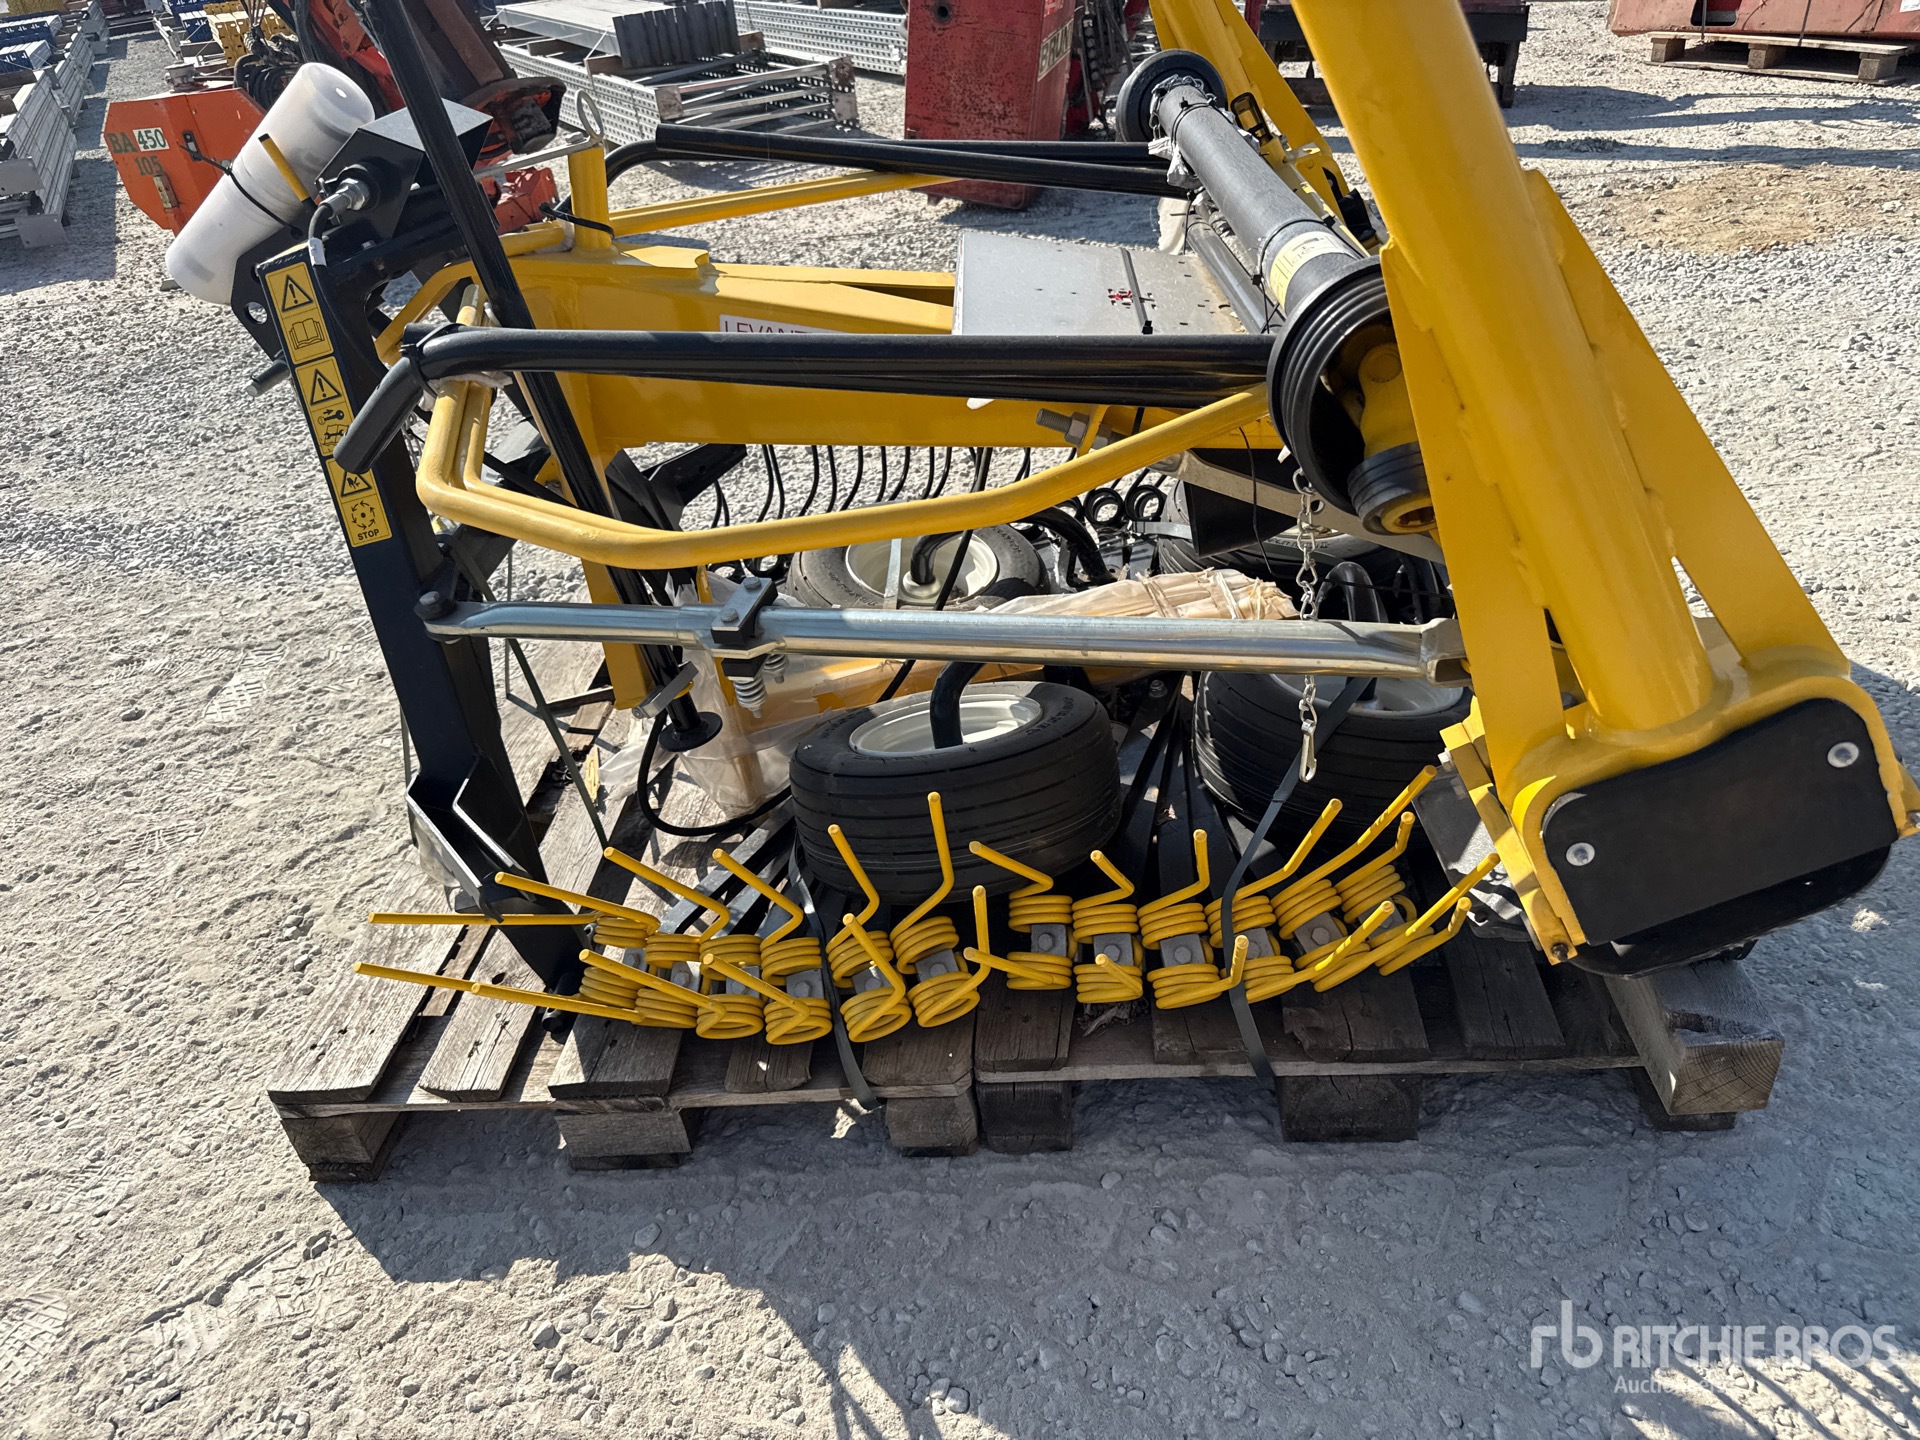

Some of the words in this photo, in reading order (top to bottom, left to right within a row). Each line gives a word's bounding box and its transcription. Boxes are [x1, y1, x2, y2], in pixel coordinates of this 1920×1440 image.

[107, 131, 137, 153] BA
[137, 128, 167, 149] 450
[135, 155, 163, 176] 105
[357, 528, 380, 541] STOP
